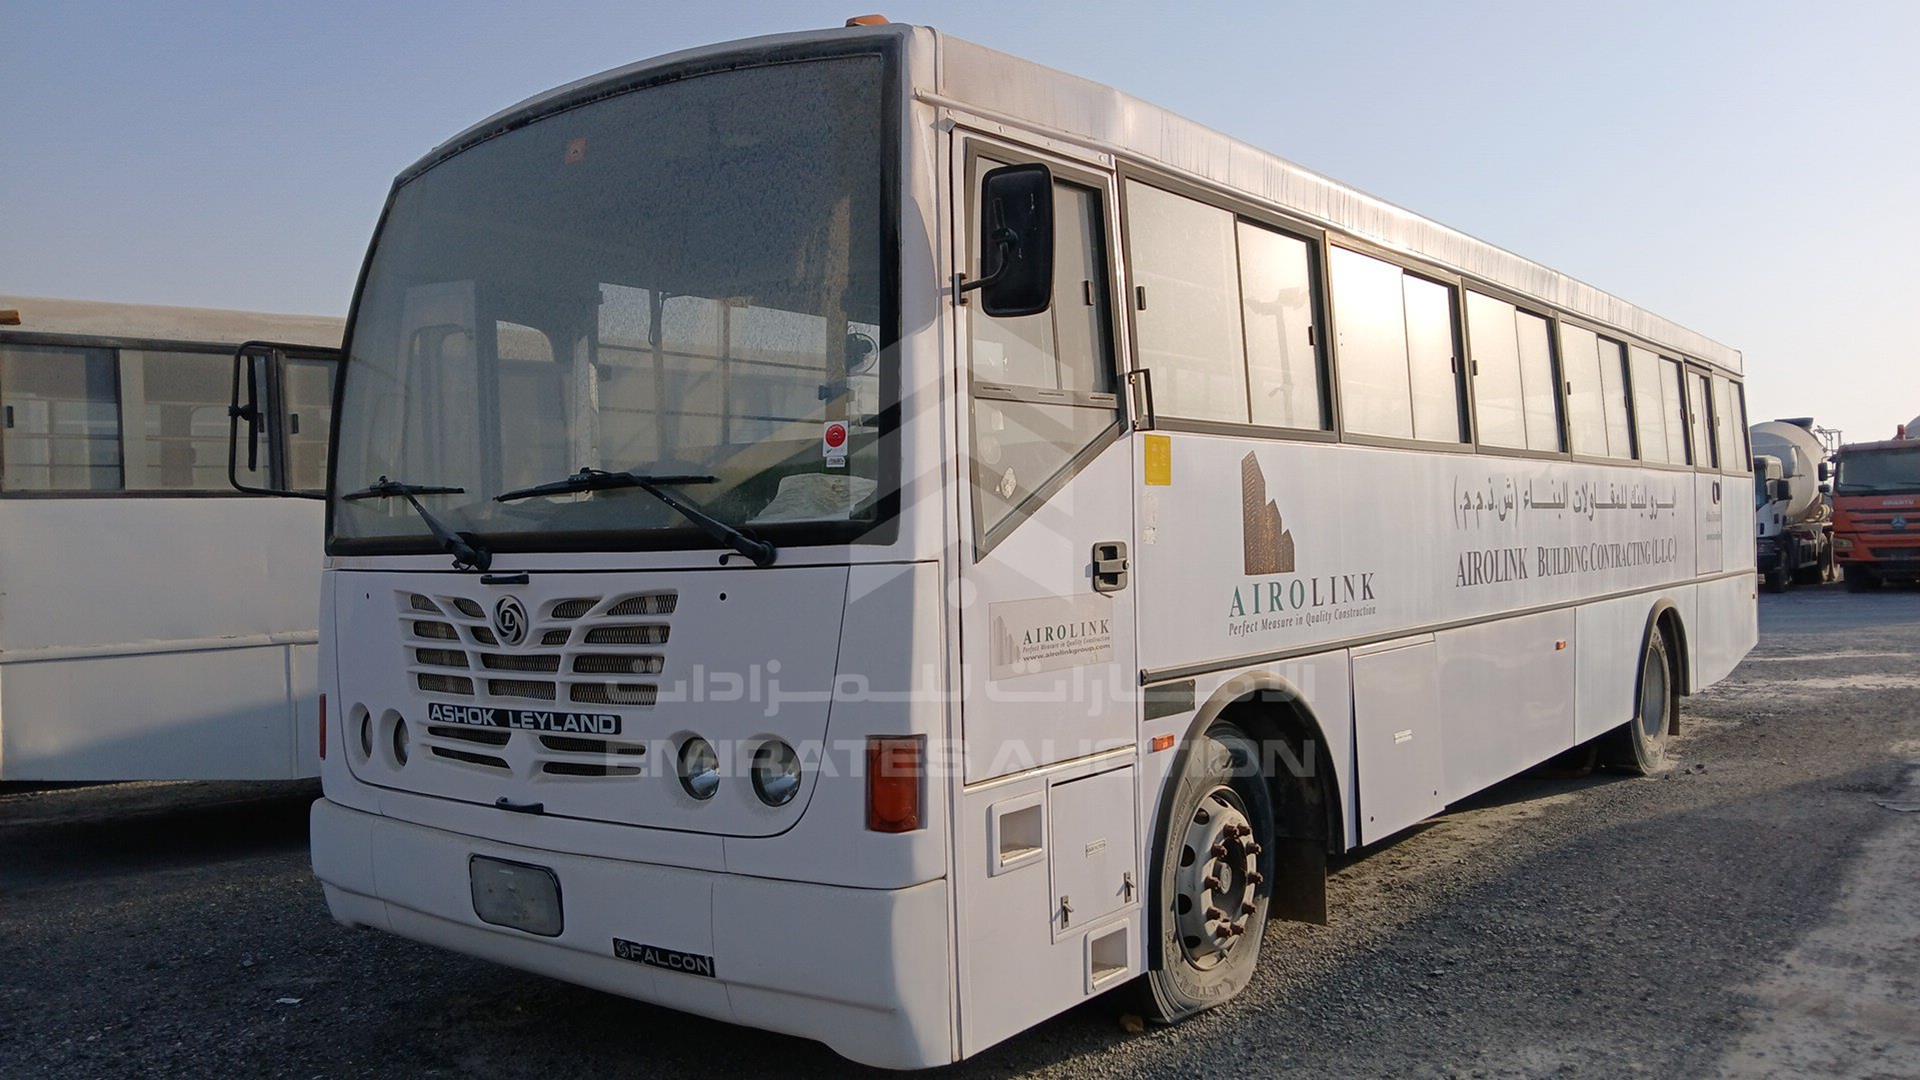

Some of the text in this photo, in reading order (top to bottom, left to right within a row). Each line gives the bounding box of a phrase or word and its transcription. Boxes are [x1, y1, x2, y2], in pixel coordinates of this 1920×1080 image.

[1455, 548, 1529, 587] AIROLINK
[1228, 572, 1376, 618] AIROLINK
[1023, 618, 1110, 646] AIROLINK
[1228, 604, 1376, 638] Perfect Measure in Quality Construction
[1022, 644, 1111, 662] www.airolinkgroup.com
[430, 704, 617, 735] ASHOK LEYLAND
[630, 944, 712, 977] FALCON
